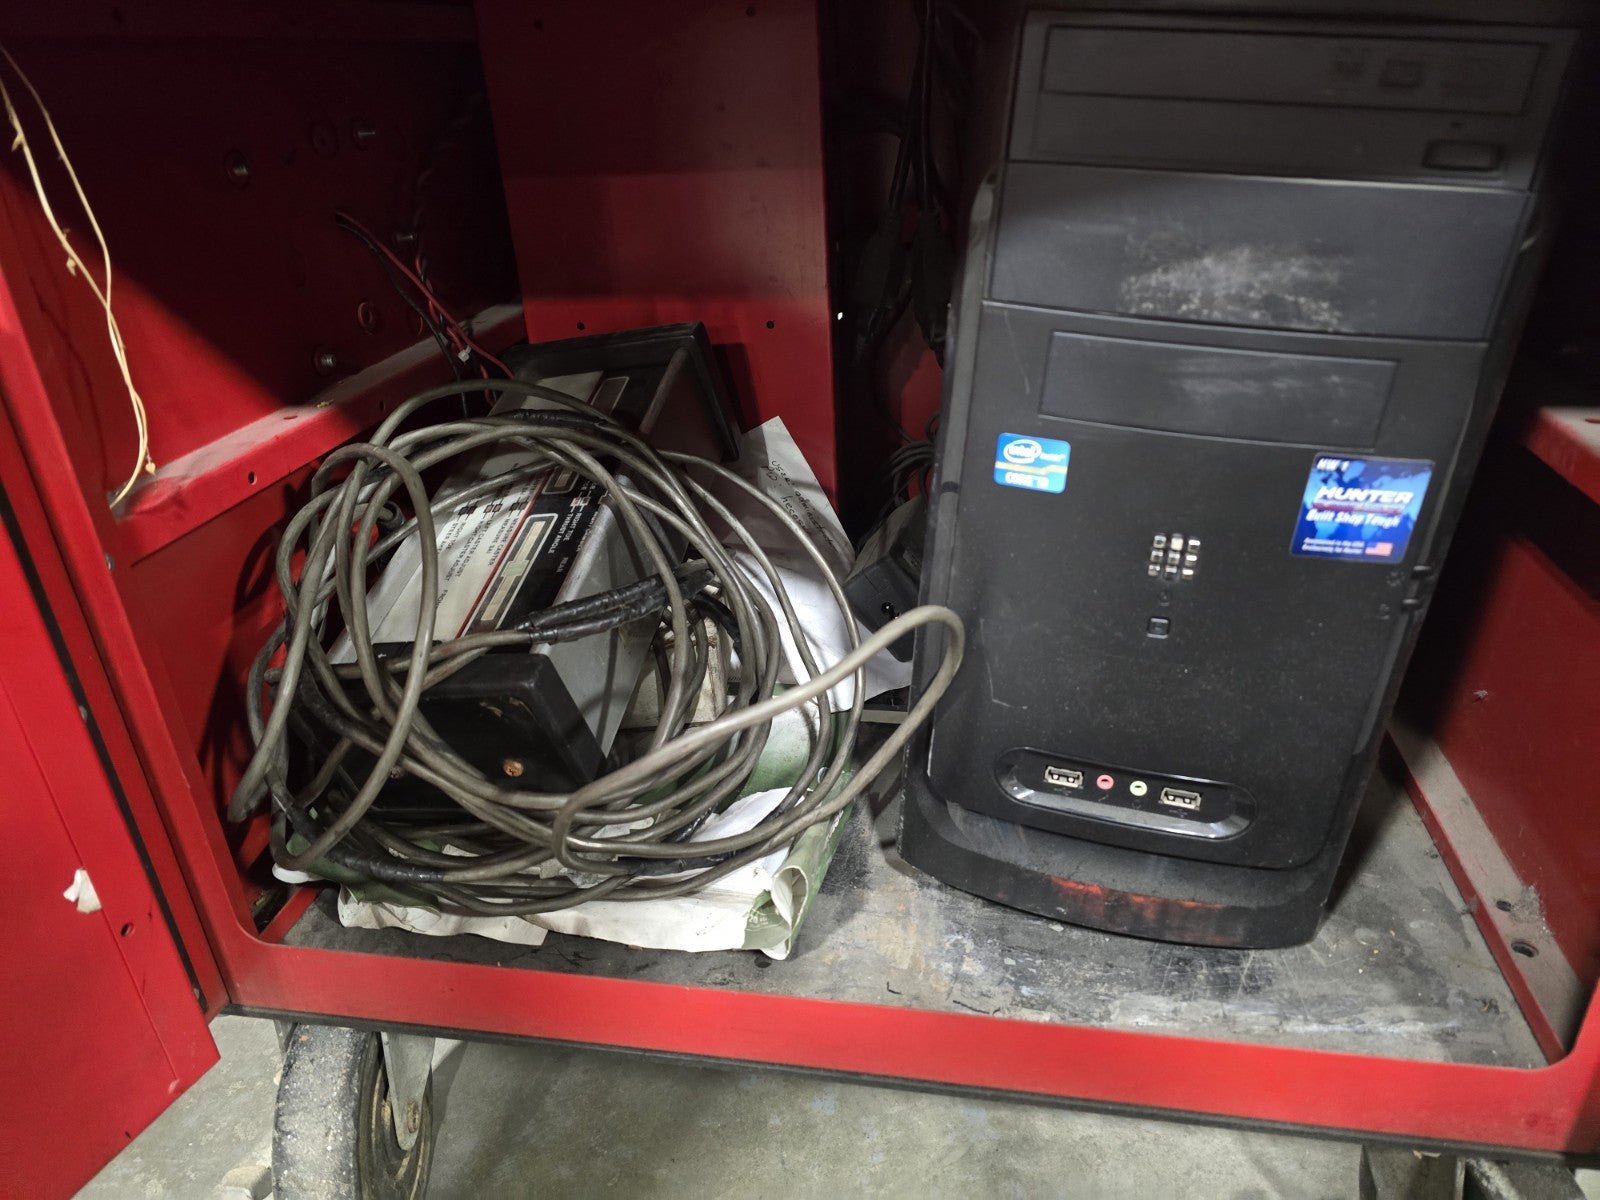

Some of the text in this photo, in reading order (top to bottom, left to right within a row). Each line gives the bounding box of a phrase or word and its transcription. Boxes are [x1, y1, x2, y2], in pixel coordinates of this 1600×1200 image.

[1316, 486, 1413, 504] HUNTER
[563, 512, 583, 541] RIGHT TOE
[1306, 509, 1335, 522] Built
[1335, 511, 1364, 526] Shop
[468, 533, 484, 554] CASTER
[488, 517, 518, 565] MEASURE CASTER
[547, 513, 574, 553] THRUST ANGLE
[457, 536, 475, 558] CASTER
[443, 559, 460, 581] ADJUST
[455, 555, 471, 576] ADJUST
